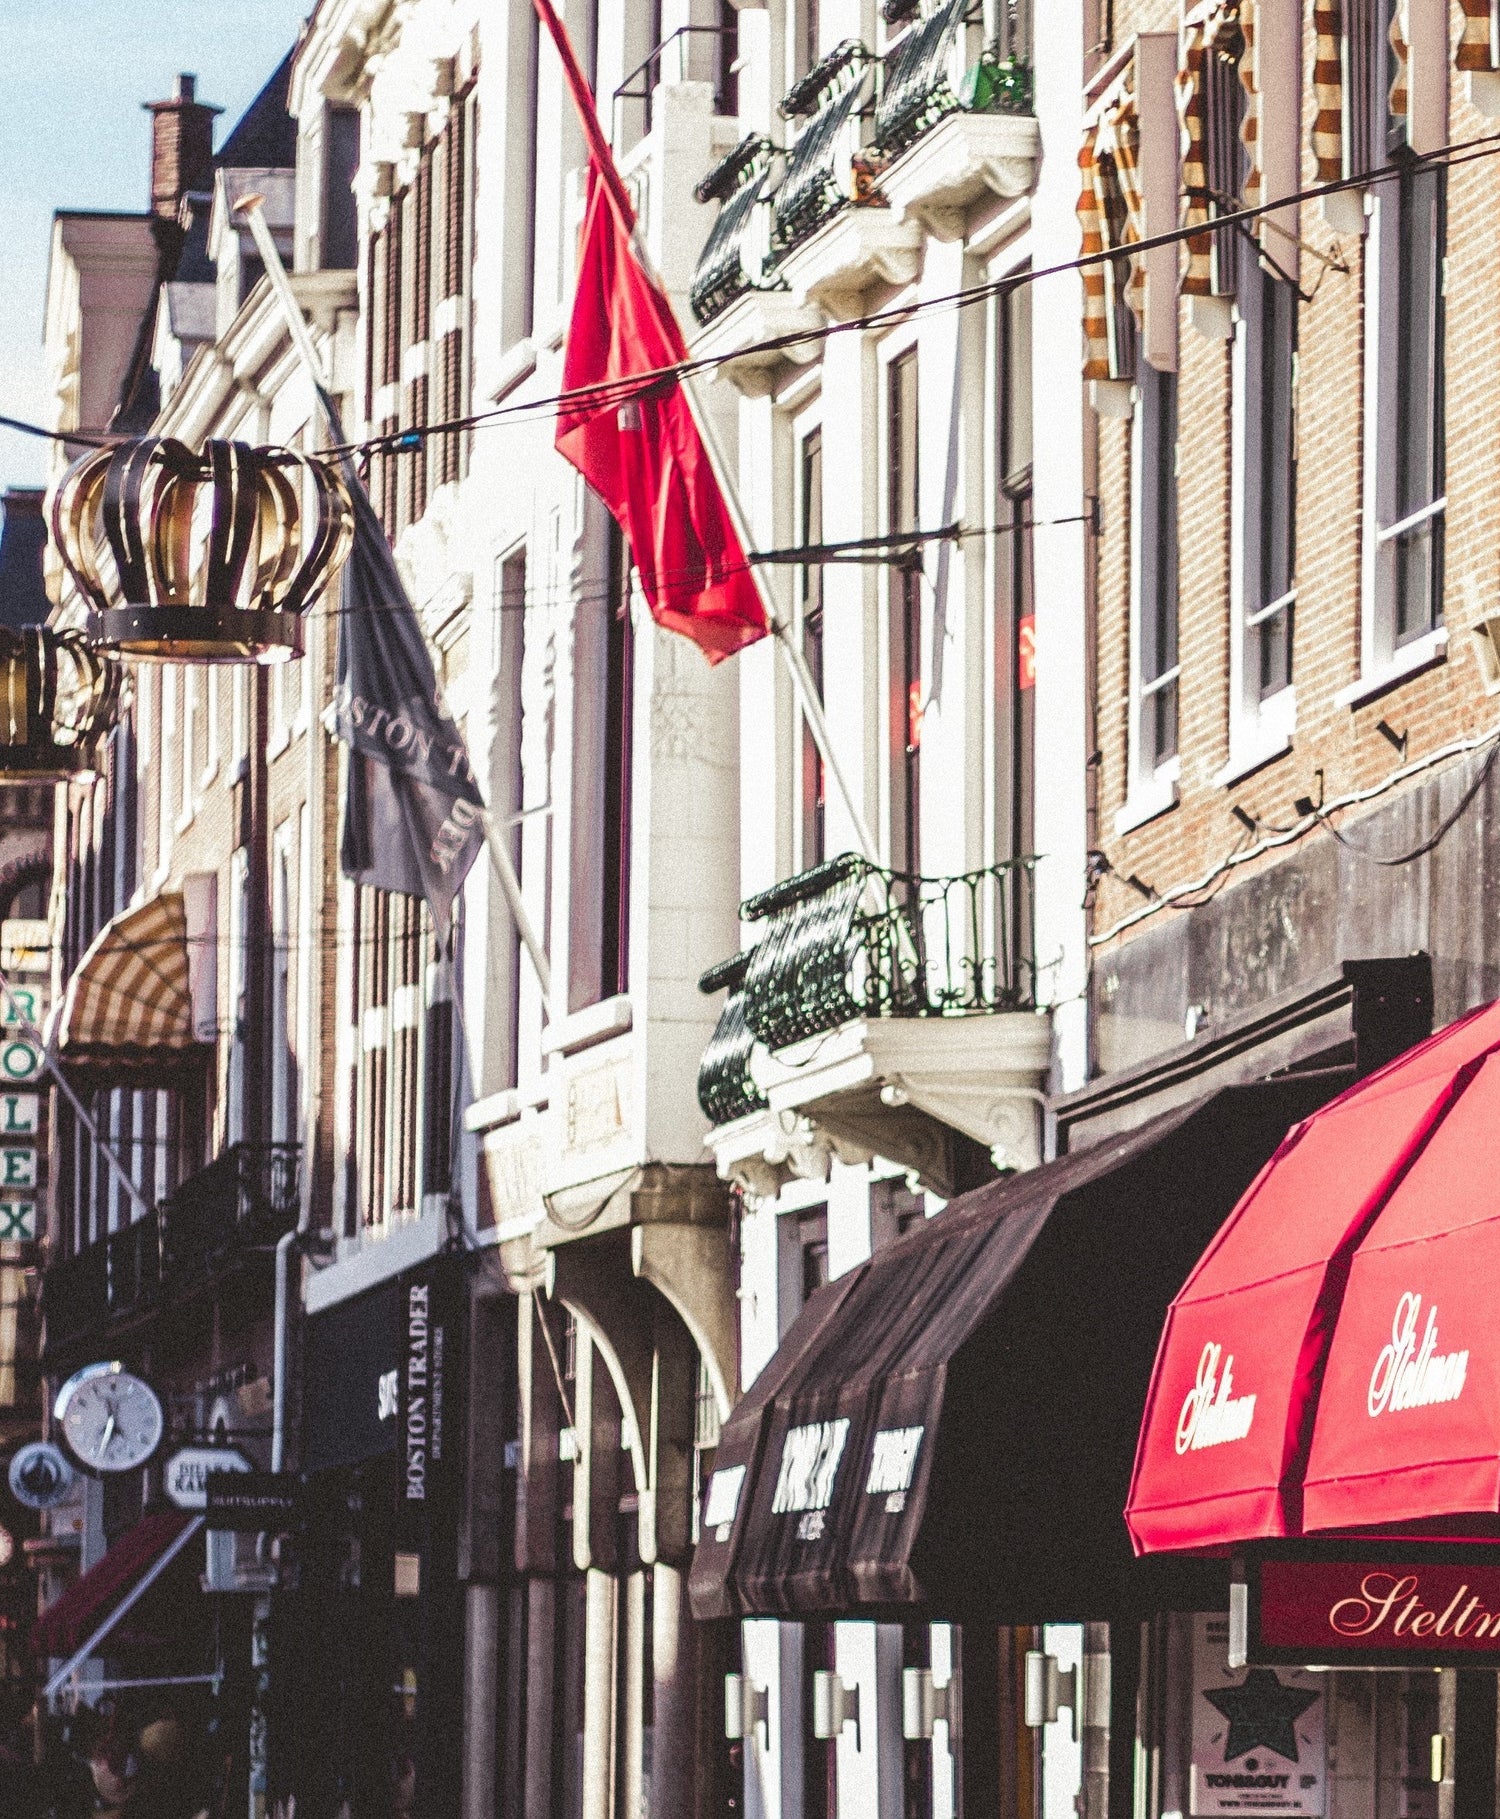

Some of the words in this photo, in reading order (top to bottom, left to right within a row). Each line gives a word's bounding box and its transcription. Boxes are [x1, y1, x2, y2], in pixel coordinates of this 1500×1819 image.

[0, 990, 36, 1241] ROLEX
[408, 1285, 429, 1391] TRADER
[1367, 1290, 1469, 1418] Steltman
[406, 1398, 427, 1499] BOSTON
[1174, 1341, 1257, 1456] Steltman
